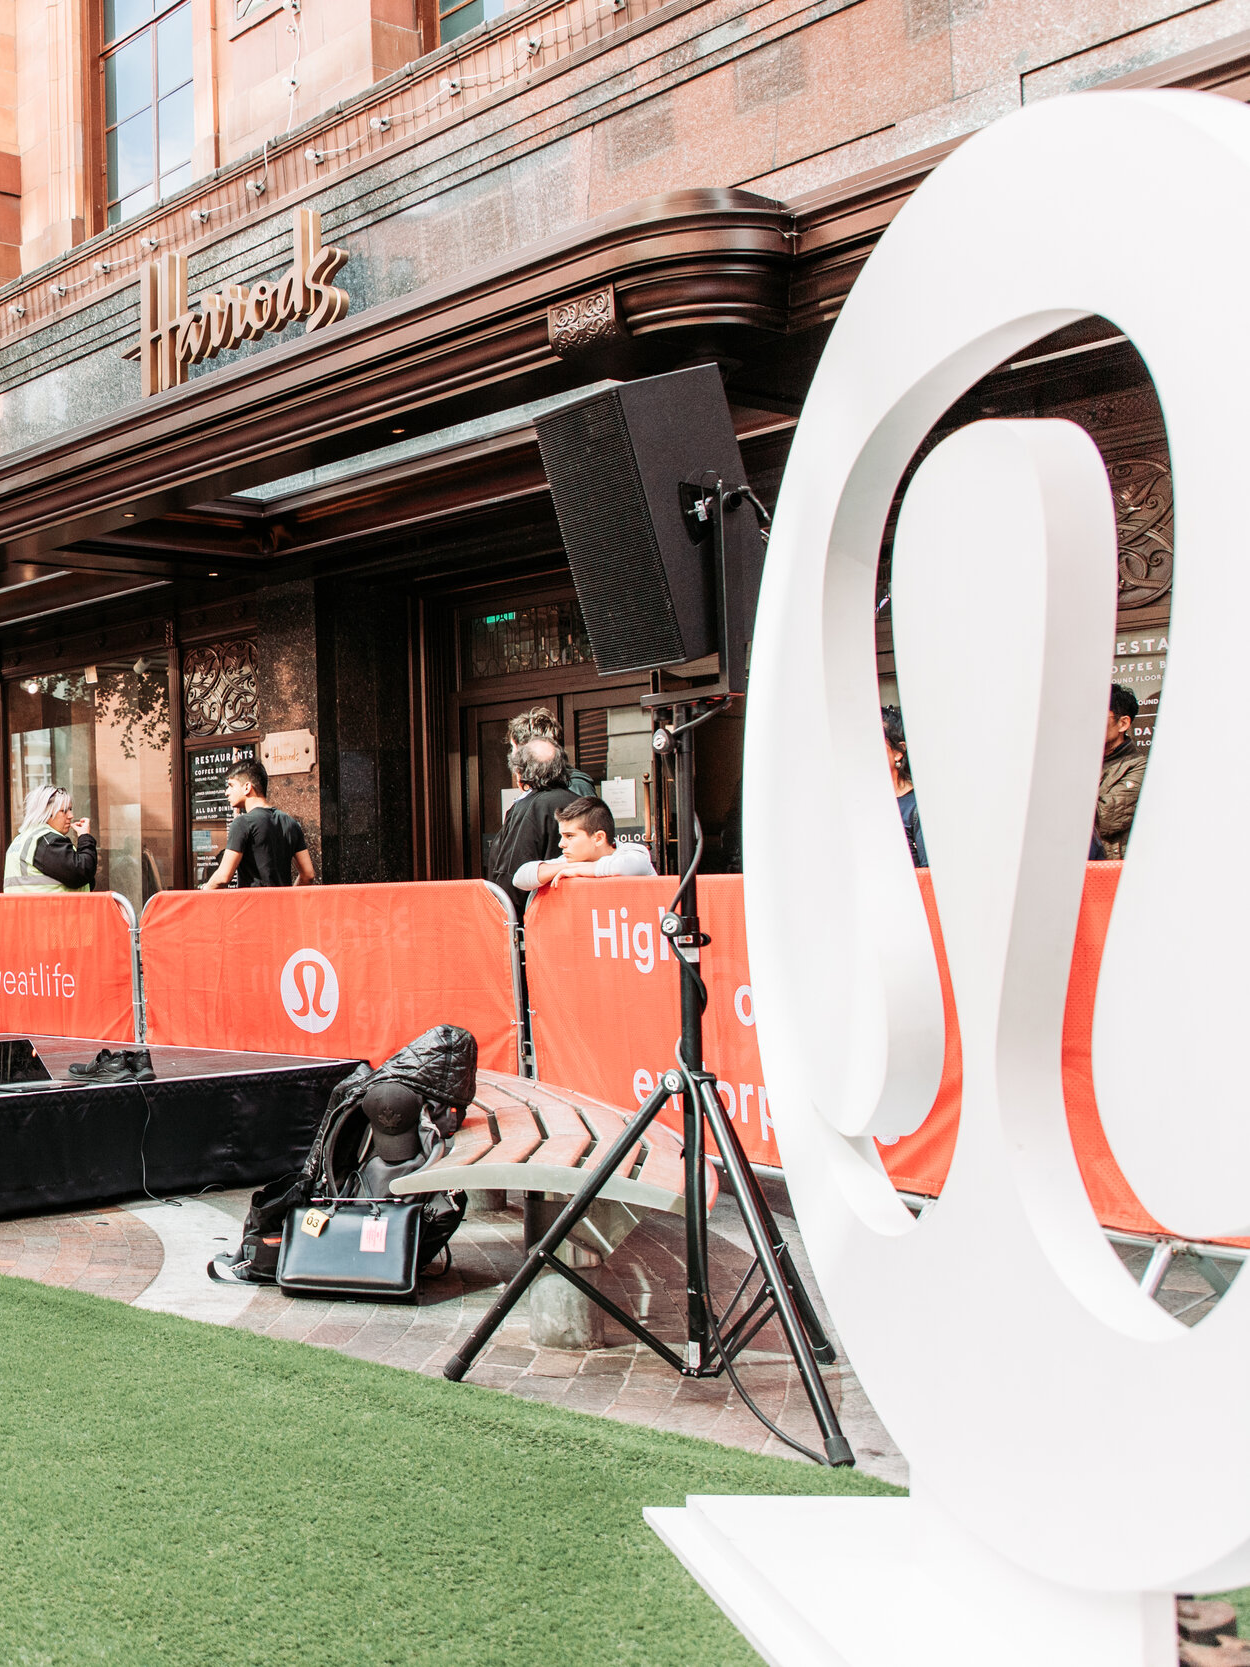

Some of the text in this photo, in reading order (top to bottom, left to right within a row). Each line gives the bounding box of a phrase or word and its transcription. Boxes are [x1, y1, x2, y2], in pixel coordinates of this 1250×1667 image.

[121, 207, 349, 398] Harrods
[1116, 637, 1169, 655] ESTA
[1111, 662, 1153, 673] OFFEE
[194, 750, 254, 766] RESTAURANTS
[194, 768, 214, 776] COFFEE
